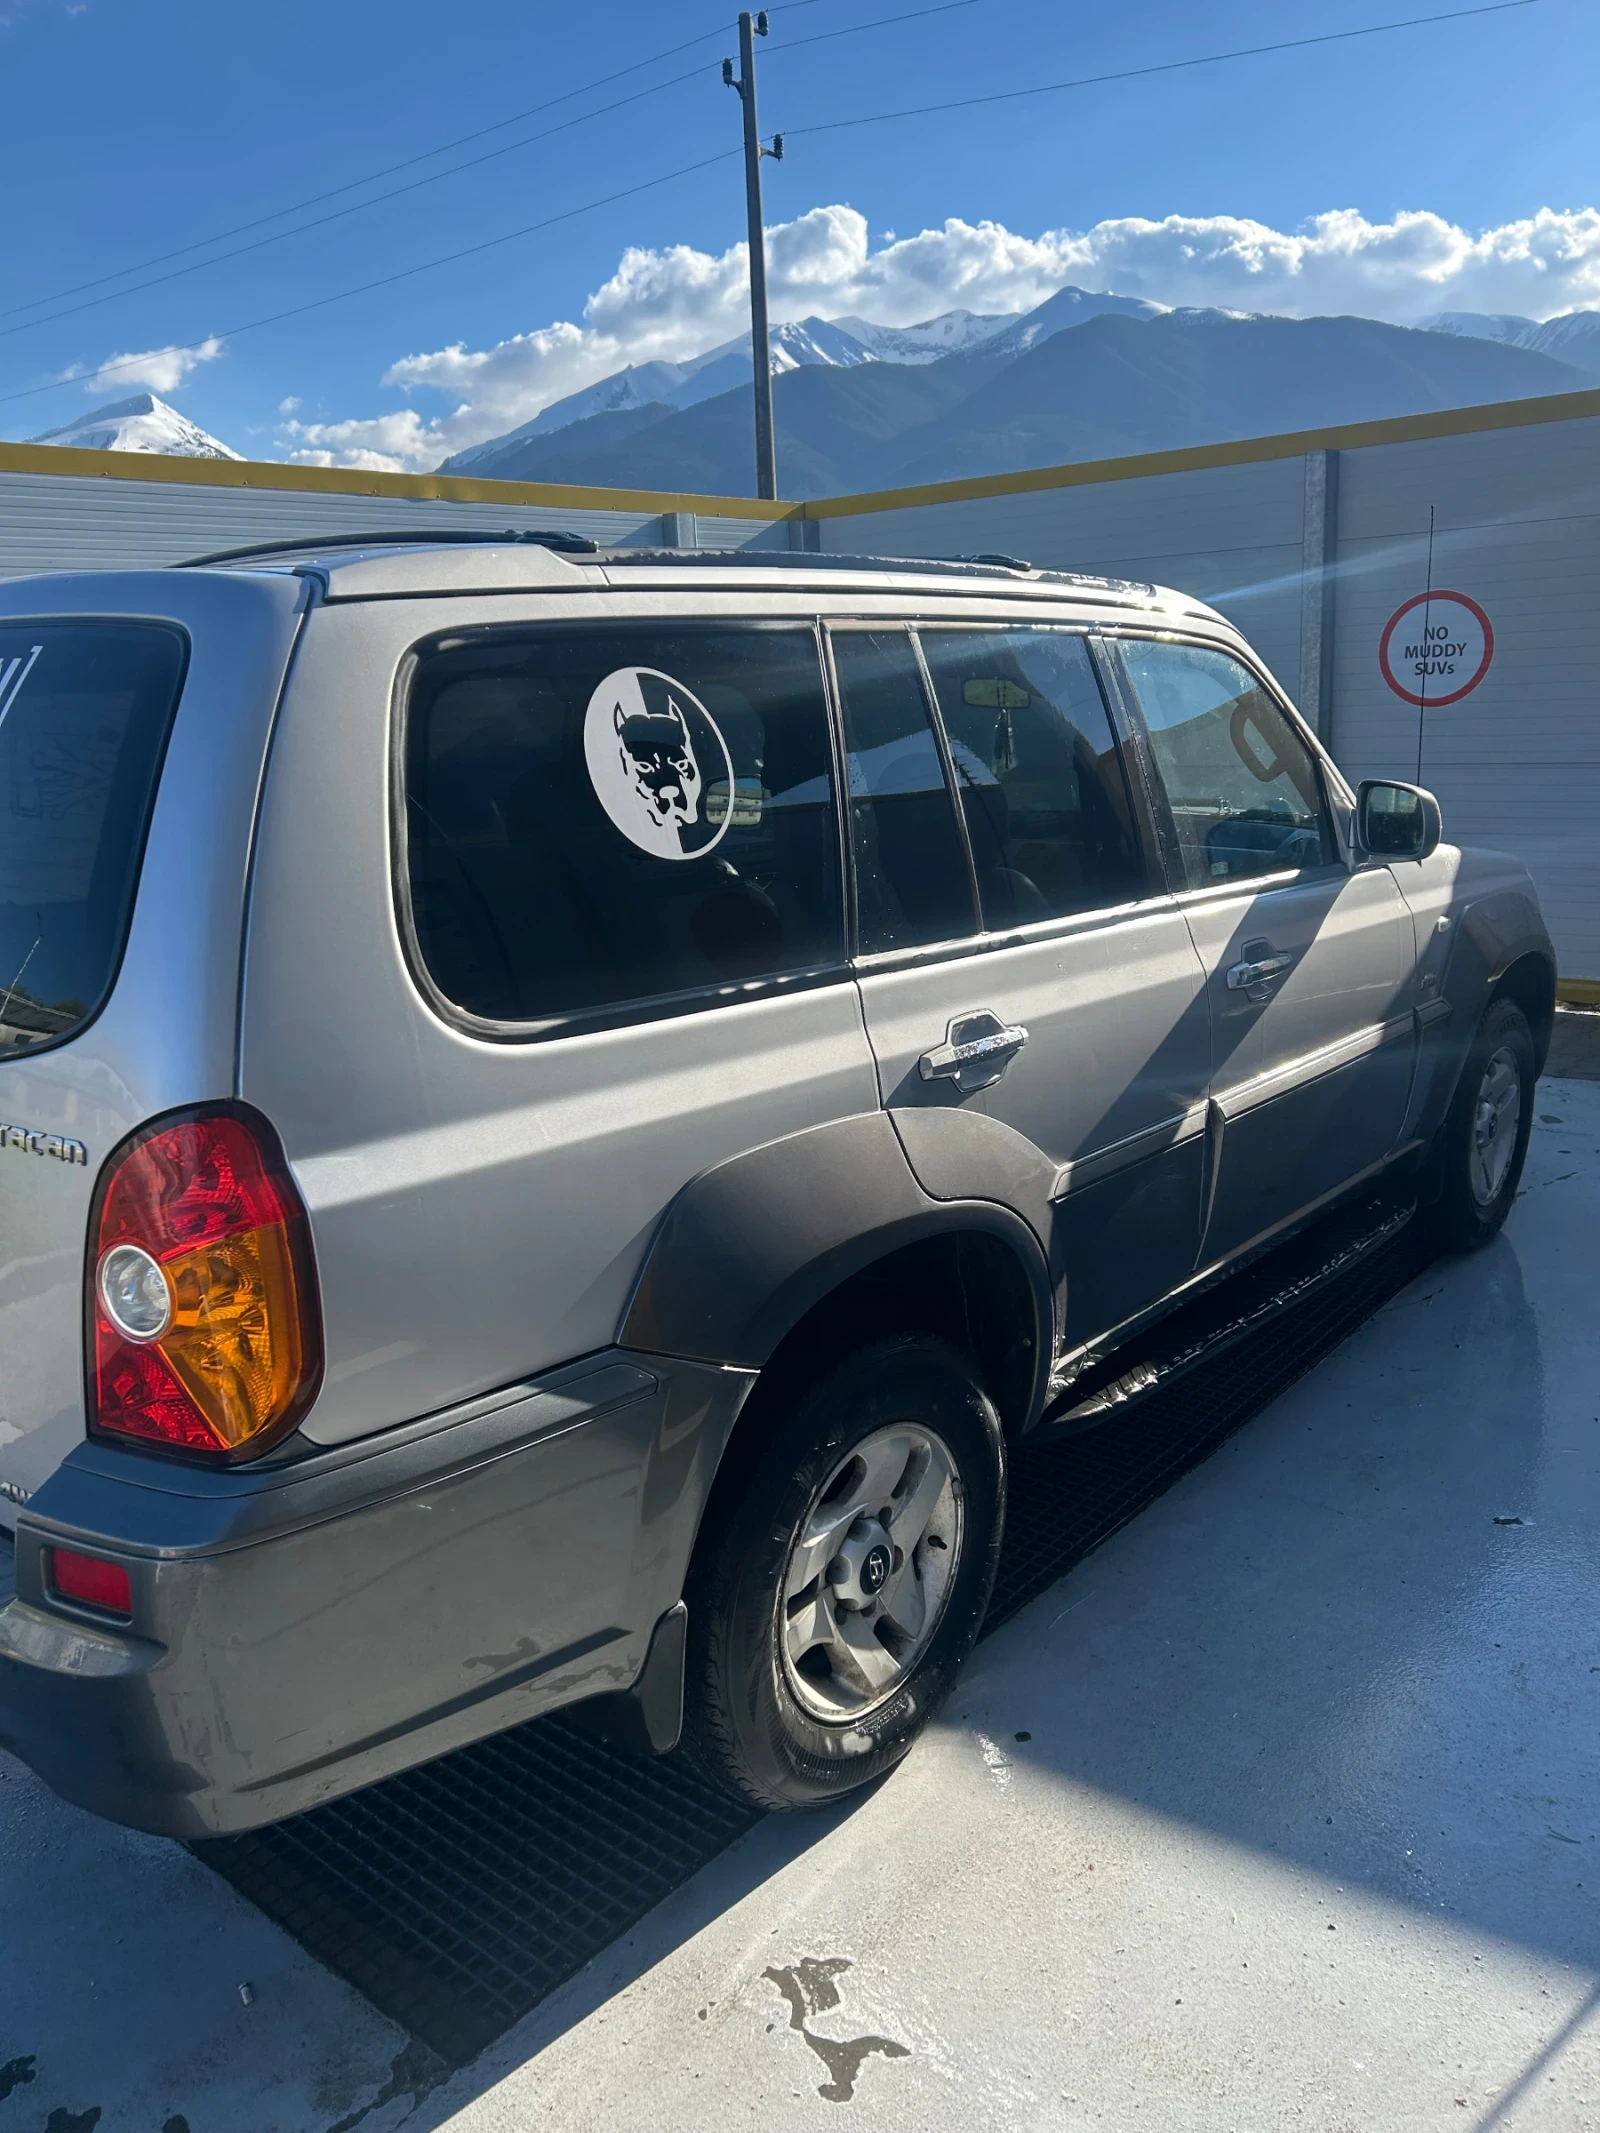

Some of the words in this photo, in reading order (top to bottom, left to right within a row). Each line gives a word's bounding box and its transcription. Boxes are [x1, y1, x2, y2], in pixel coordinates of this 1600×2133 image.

[1424, 626, 1449, 641] NO
[1404, 643, 1467, 659] MUDDY
[1414, 661, 1455, 676] SUVs
